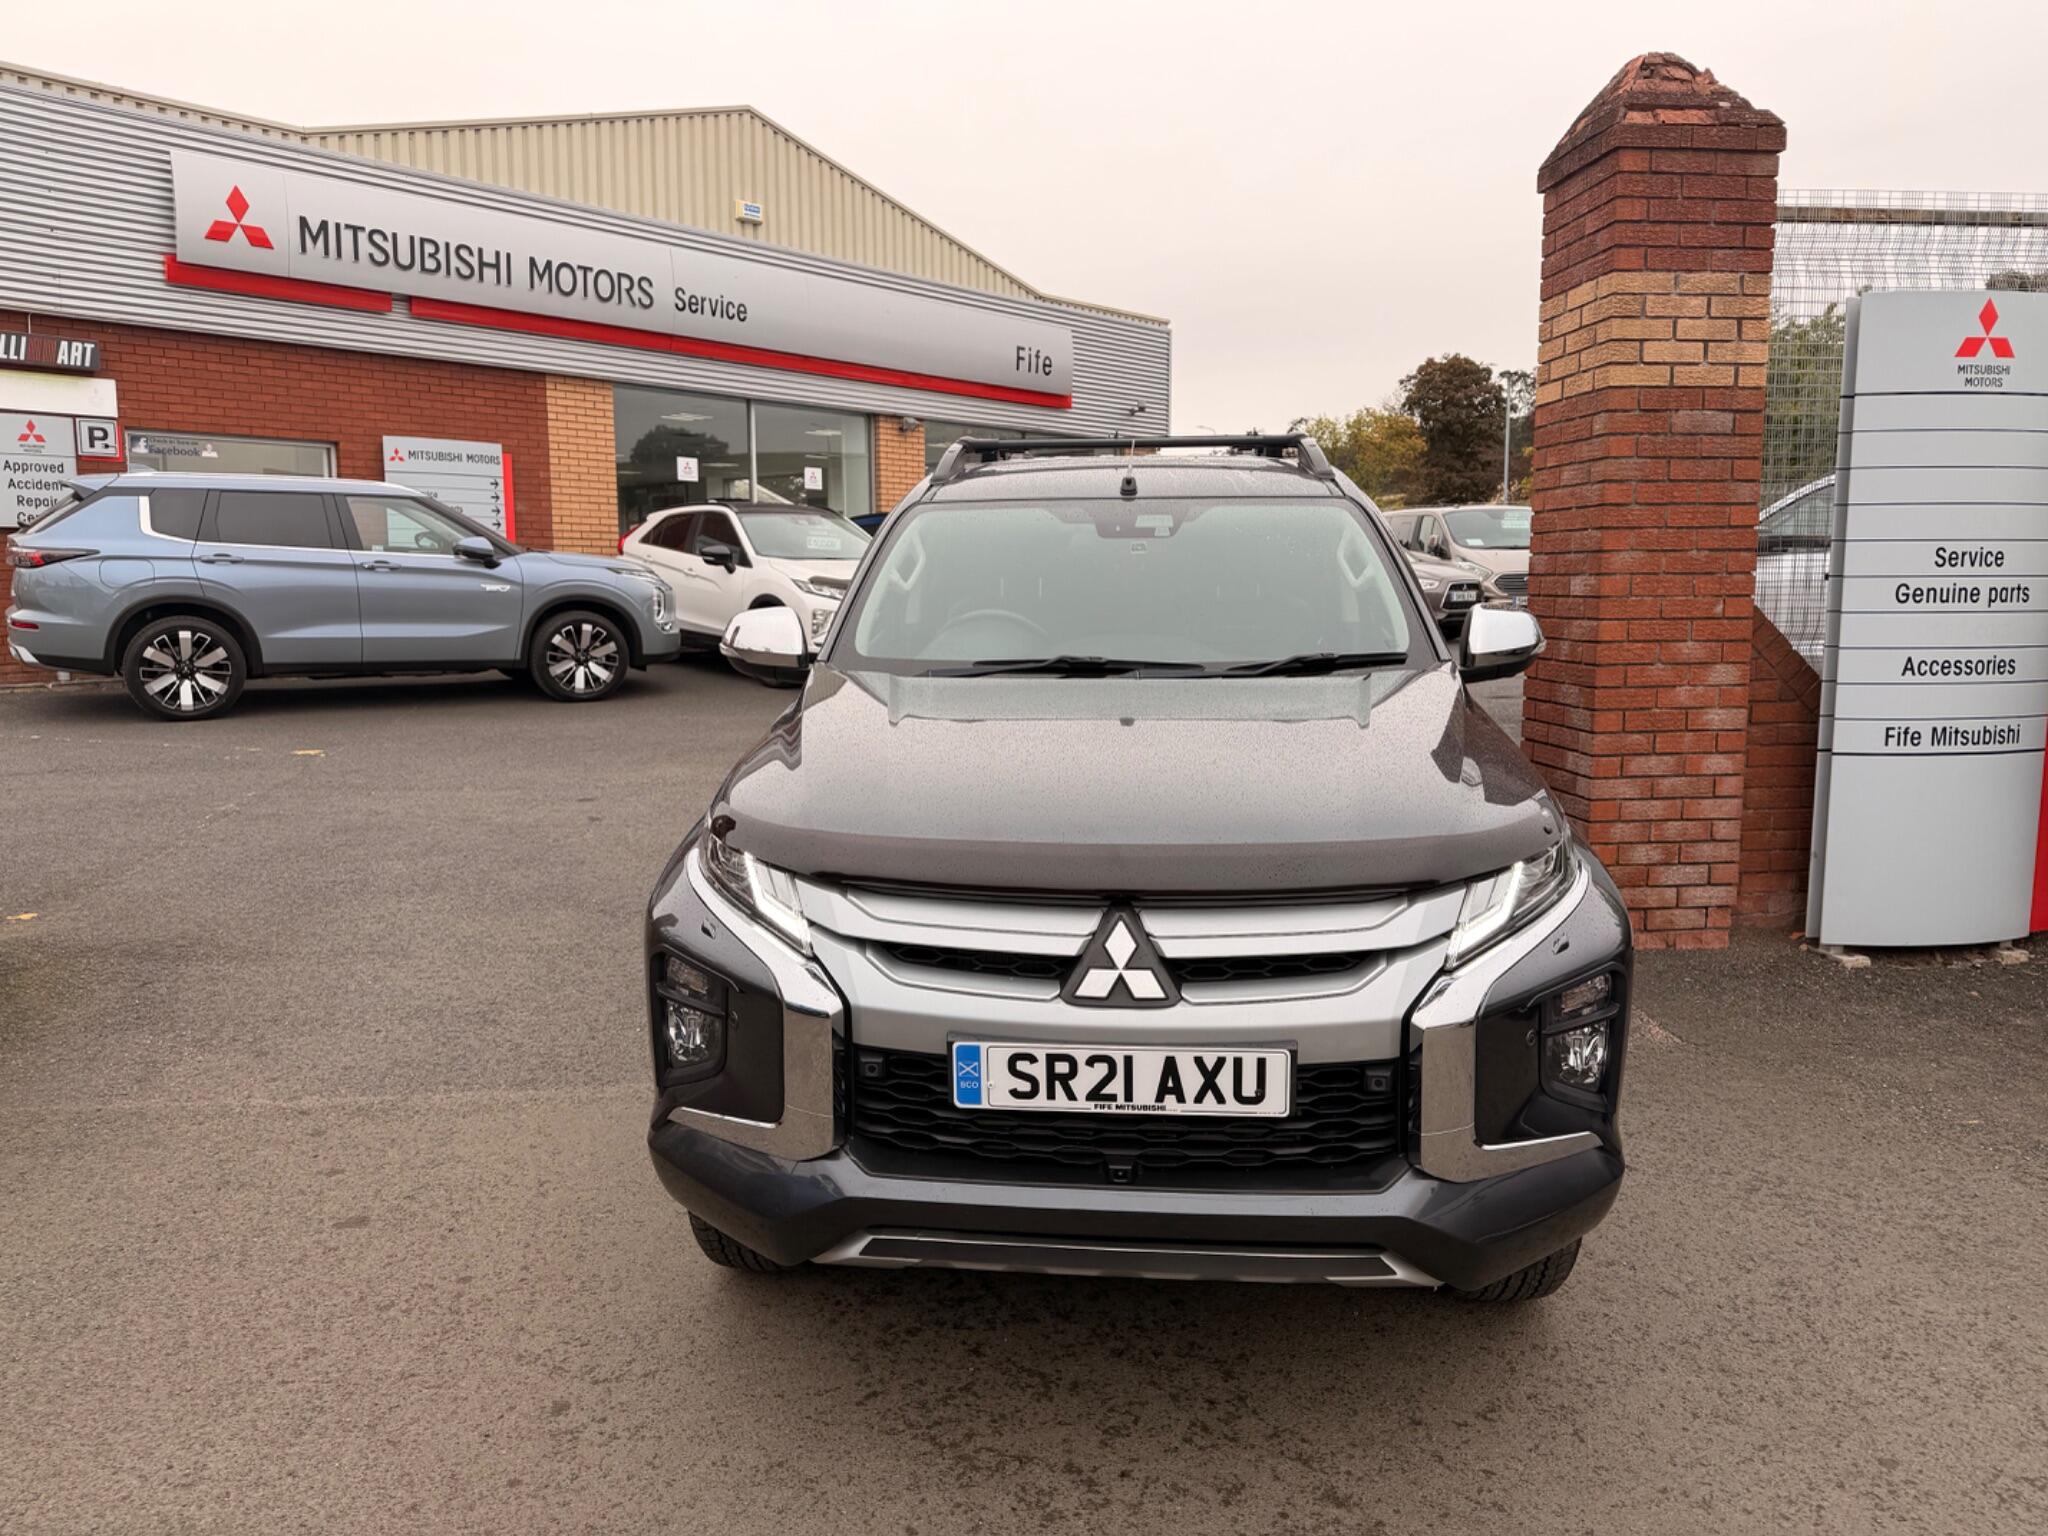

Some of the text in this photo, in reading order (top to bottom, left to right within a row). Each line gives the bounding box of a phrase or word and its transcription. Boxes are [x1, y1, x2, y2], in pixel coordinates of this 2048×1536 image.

[299, 216, 655, 309] MITSUBISHI MOTORS
[674, 287, 748, 322] Service
[1015, 346, 1053, 377] Fife
[1957, 364, 2011, 376] MITSUBISHI
[1964, 377, 2004, 388] MOTORS
[87, 426, 109, 449] P
[3, 460, 65, 474] Approved
[408, 450, 501, 466] MITSUBISHI MOTORS
[16, 495, 58, 509] Repair
[1934, 546, 2005, 568] Service
[1895, 582, 2030, 608] Genuine parts
[1901, 655, 2016, 677] Accessories
[1884, 724, 2021, 747] Fife Mitsubishi
[1007, 1052, 1267, 1106] SR21 AXU
[1093, 1103, 1167, 1112] FIFE MITSUBISHI
